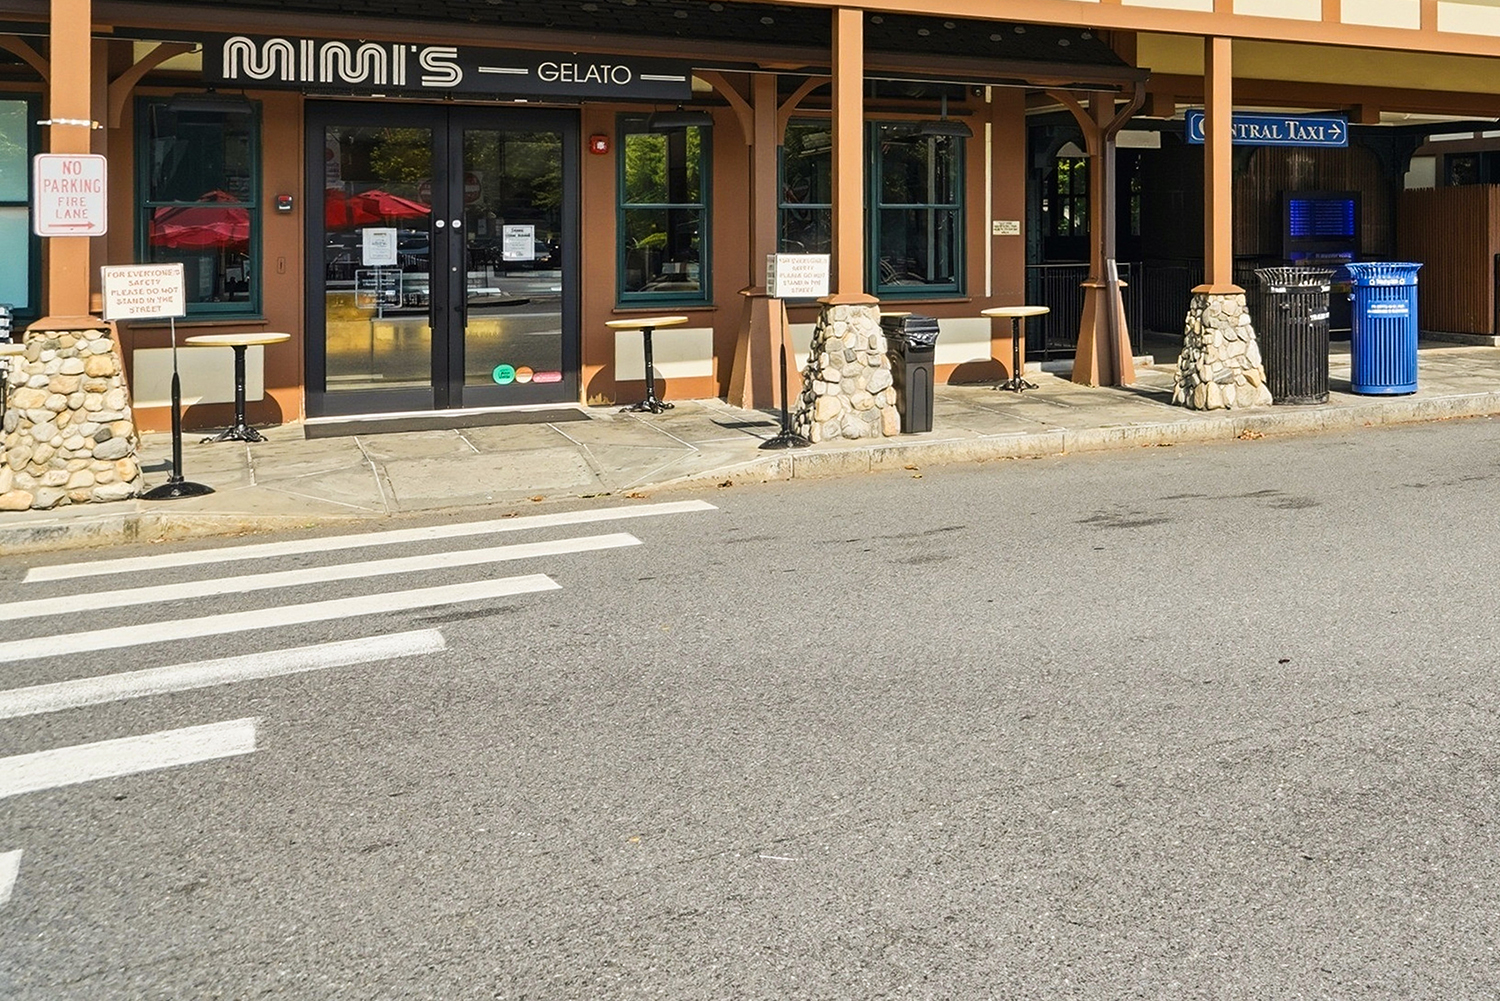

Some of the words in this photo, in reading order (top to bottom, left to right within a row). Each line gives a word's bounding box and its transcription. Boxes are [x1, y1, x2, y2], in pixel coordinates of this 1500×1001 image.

[222, 35, 463, 87] MIMI'S
[536, 61, 632, 85] GELATO
[1198, 117, 1283, 140] NTRAL
[1285, 120, 1325, 141] TAXI
[62, 160, 82, 175] NO
[43, 178, 101, 193] PARKING
[58, 197, 86, 207] FIRE
[55, 208, 89, 219] LANE
[107, 271, 126, 279] FOR
[111, 288, 145, 297] PLEASE
